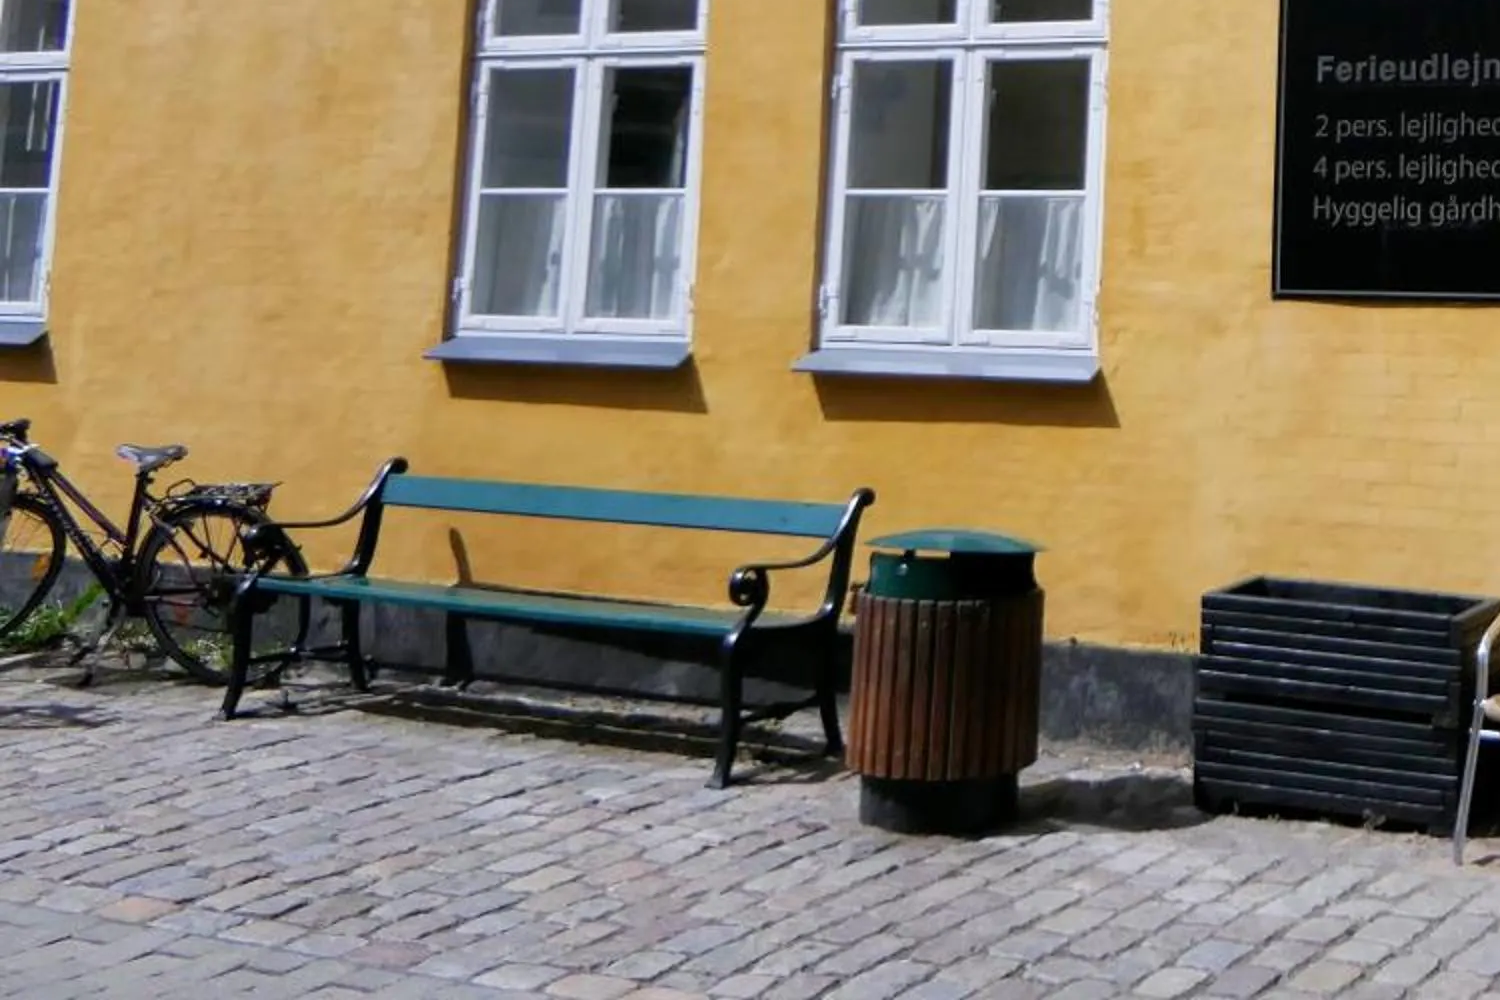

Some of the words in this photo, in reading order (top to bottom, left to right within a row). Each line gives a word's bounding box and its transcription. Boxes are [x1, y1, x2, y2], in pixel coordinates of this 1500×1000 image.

[1315, 114, 1329, 138] 2
[1335, 116, 1393, 144] pers.
[1313, 156, 1328, 180] 4
[1334, 159, 1392, 185] pers.
[1312, 196, 1422, 227] Hyggelig
